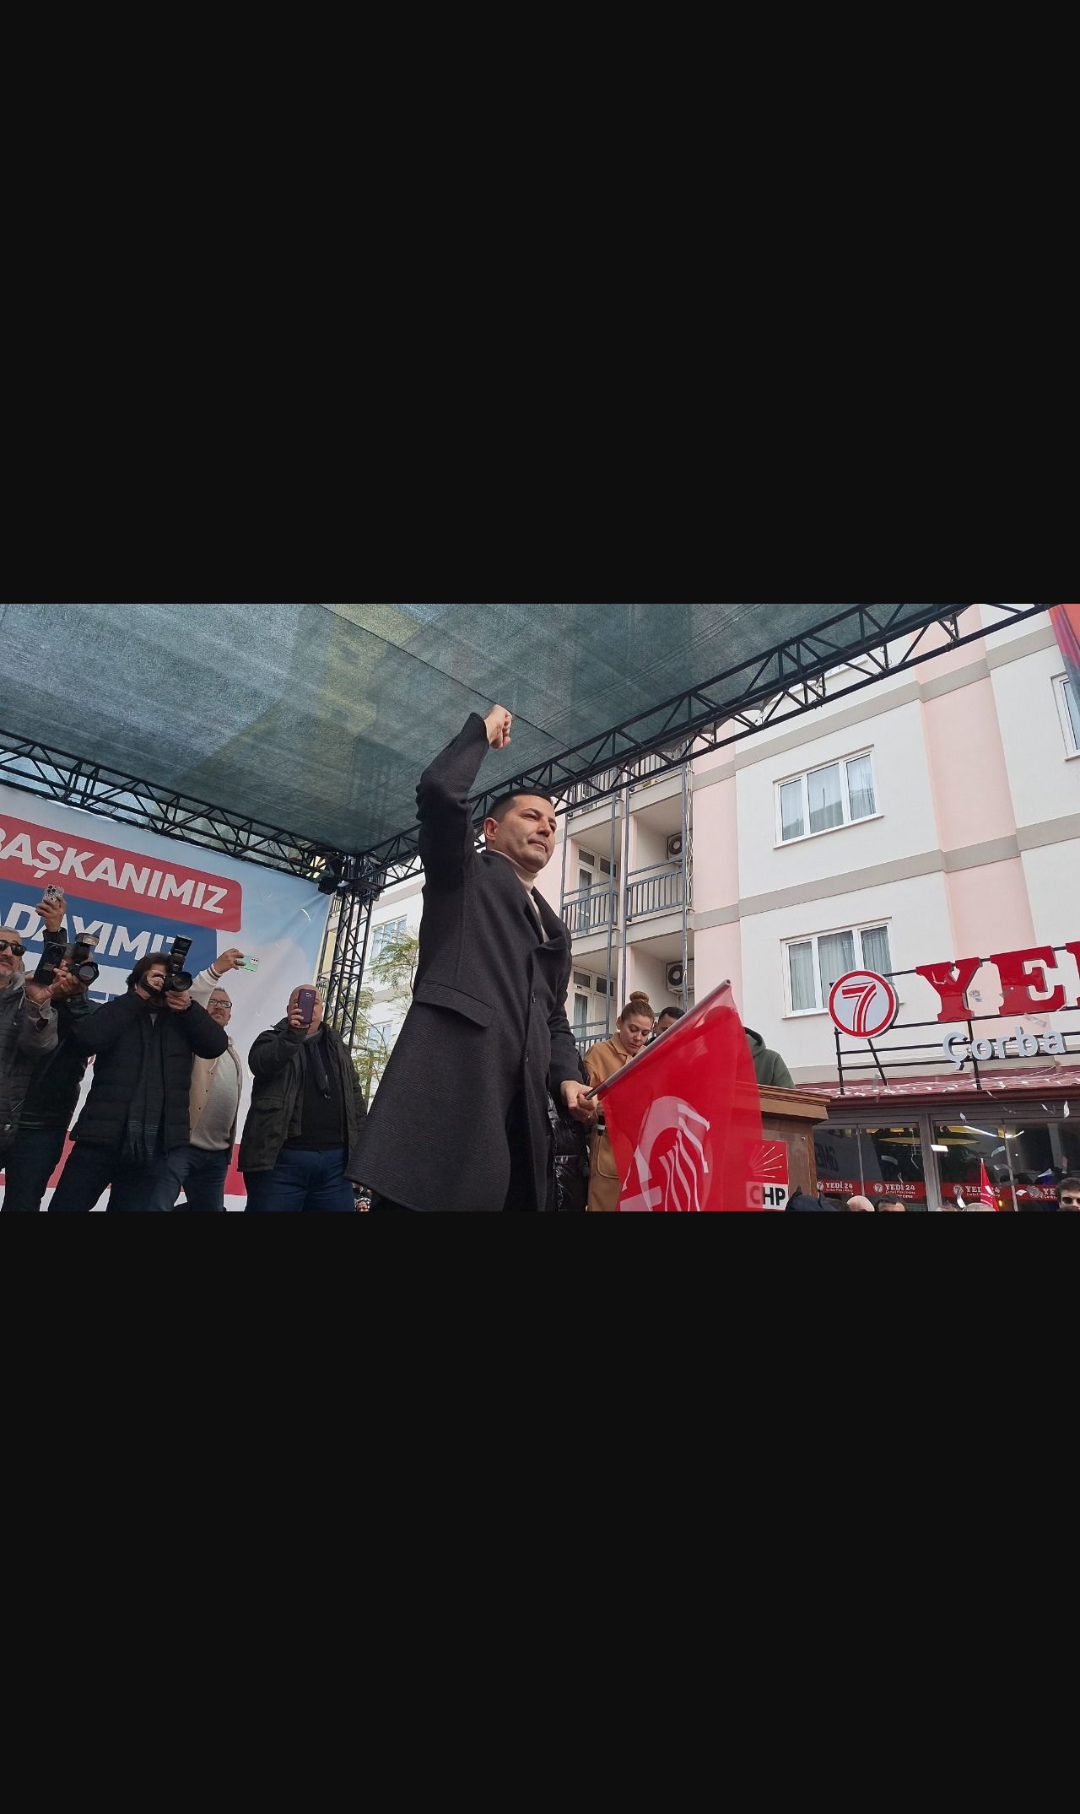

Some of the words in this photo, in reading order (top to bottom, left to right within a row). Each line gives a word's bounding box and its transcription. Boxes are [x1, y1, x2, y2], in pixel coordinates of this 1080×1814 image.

[0, 827, 228, 914] AŞKANIMIZ
[0, 902, 177, 961] DAYIMI
[841, 981, 878, 1034] 7
[915, 941, 1080, 1024] YE
[942, 1026, 1067, 1071] Çorba
[751, 1184, 786, 1206] CHP
